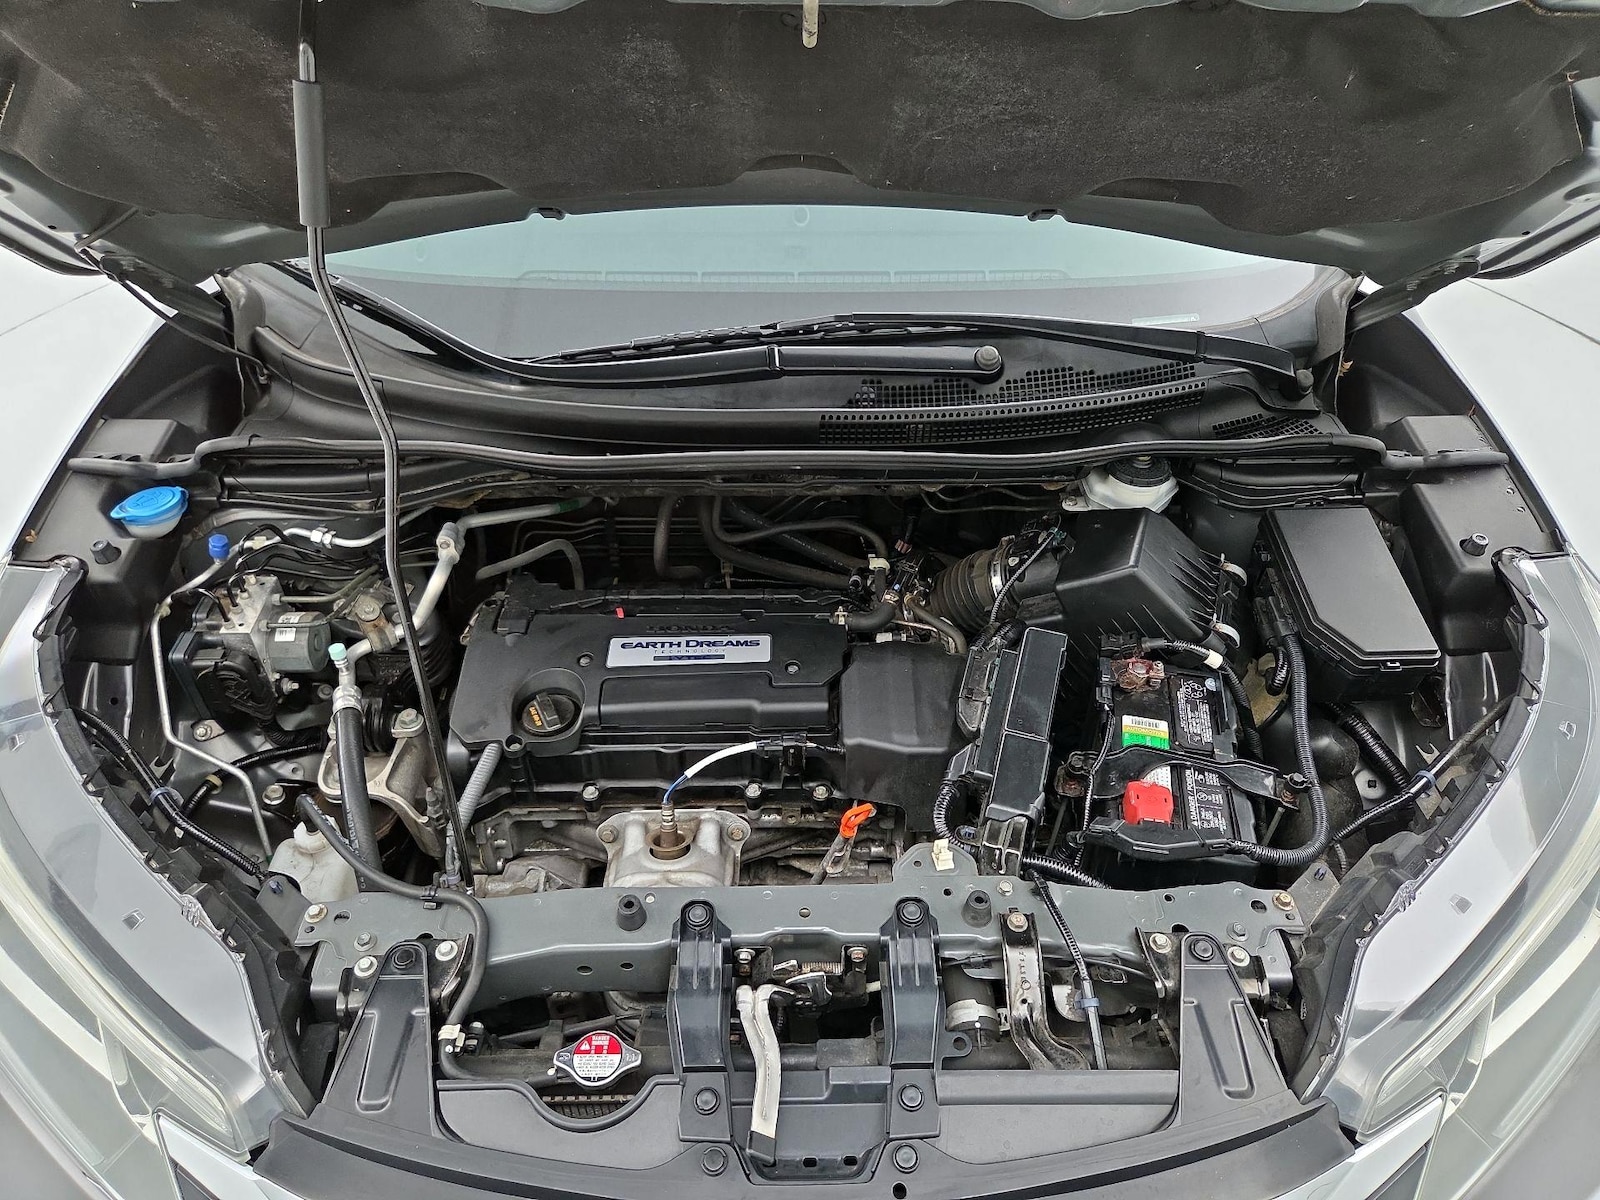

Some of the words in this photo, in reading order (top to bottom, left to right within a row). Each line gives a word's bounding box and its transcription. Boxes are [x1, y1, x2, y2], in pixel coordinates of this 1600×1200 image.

[620, 641, 682, 650] EARTH
[685, 639, 761, 648] DREAMS
[1185, 769, 1193, 791] POISON
[1188, 796, 1198, 820] DANGER
